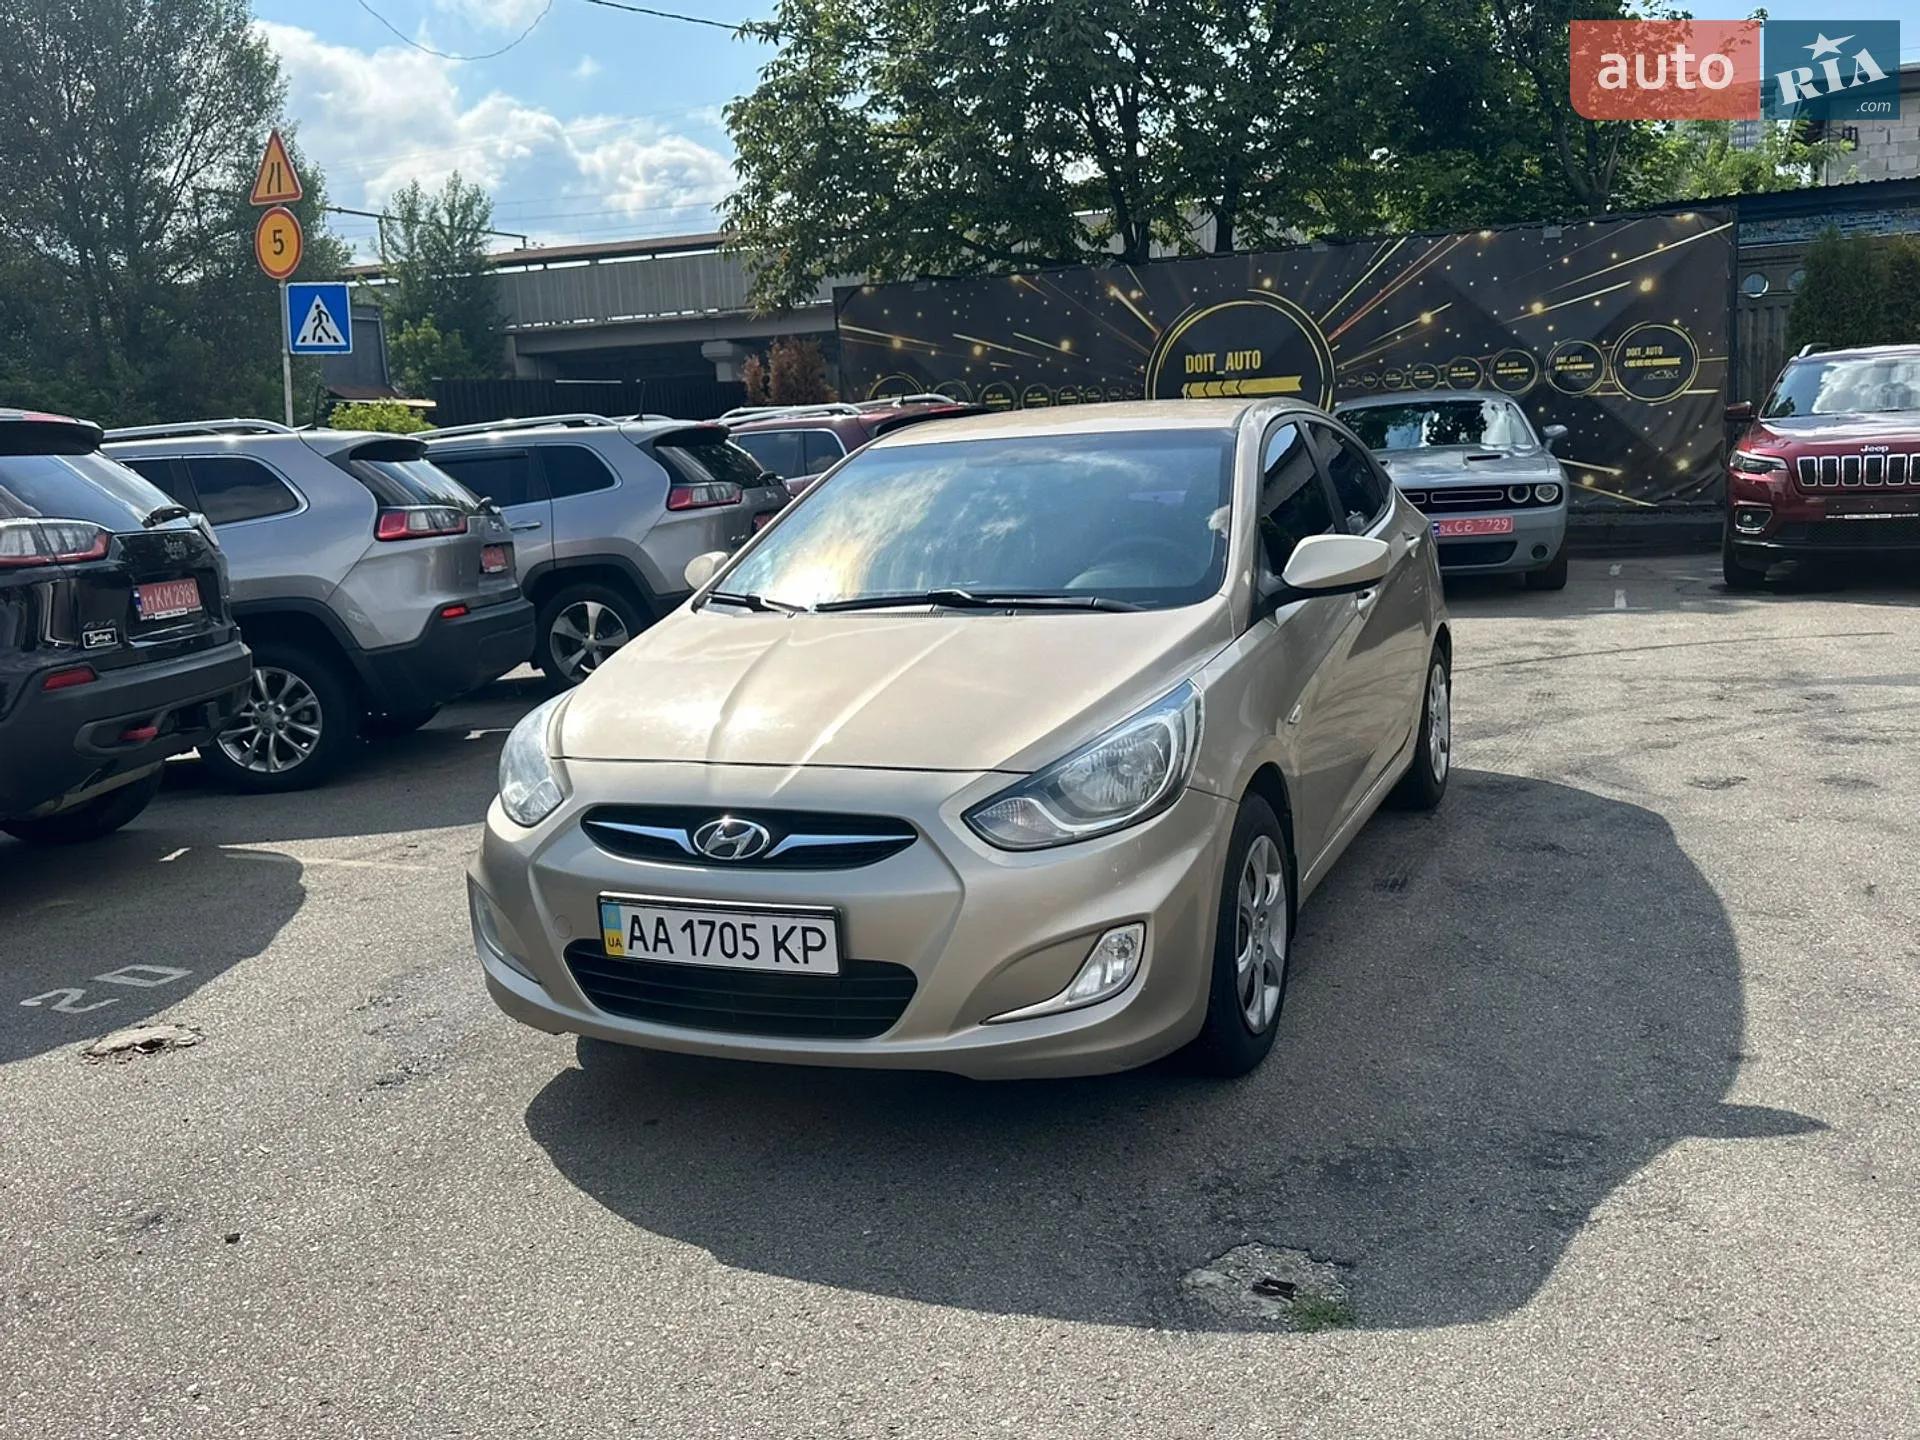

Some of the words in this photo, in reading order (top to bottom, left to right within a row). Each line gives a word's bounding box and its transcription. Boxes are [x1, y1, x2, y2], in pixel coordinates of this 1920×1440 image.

[272, 229, 285, 256] 5
[1185, 349, 1262, 375] DOIT_AUTO
[1860, 445, 1889, 453] Jeep
[607, 936, 623, 949] UA
[628, 914, 675, 955] AA
[680, 918, 760, 961] 1705
[772, 924, 827, 965] KP
